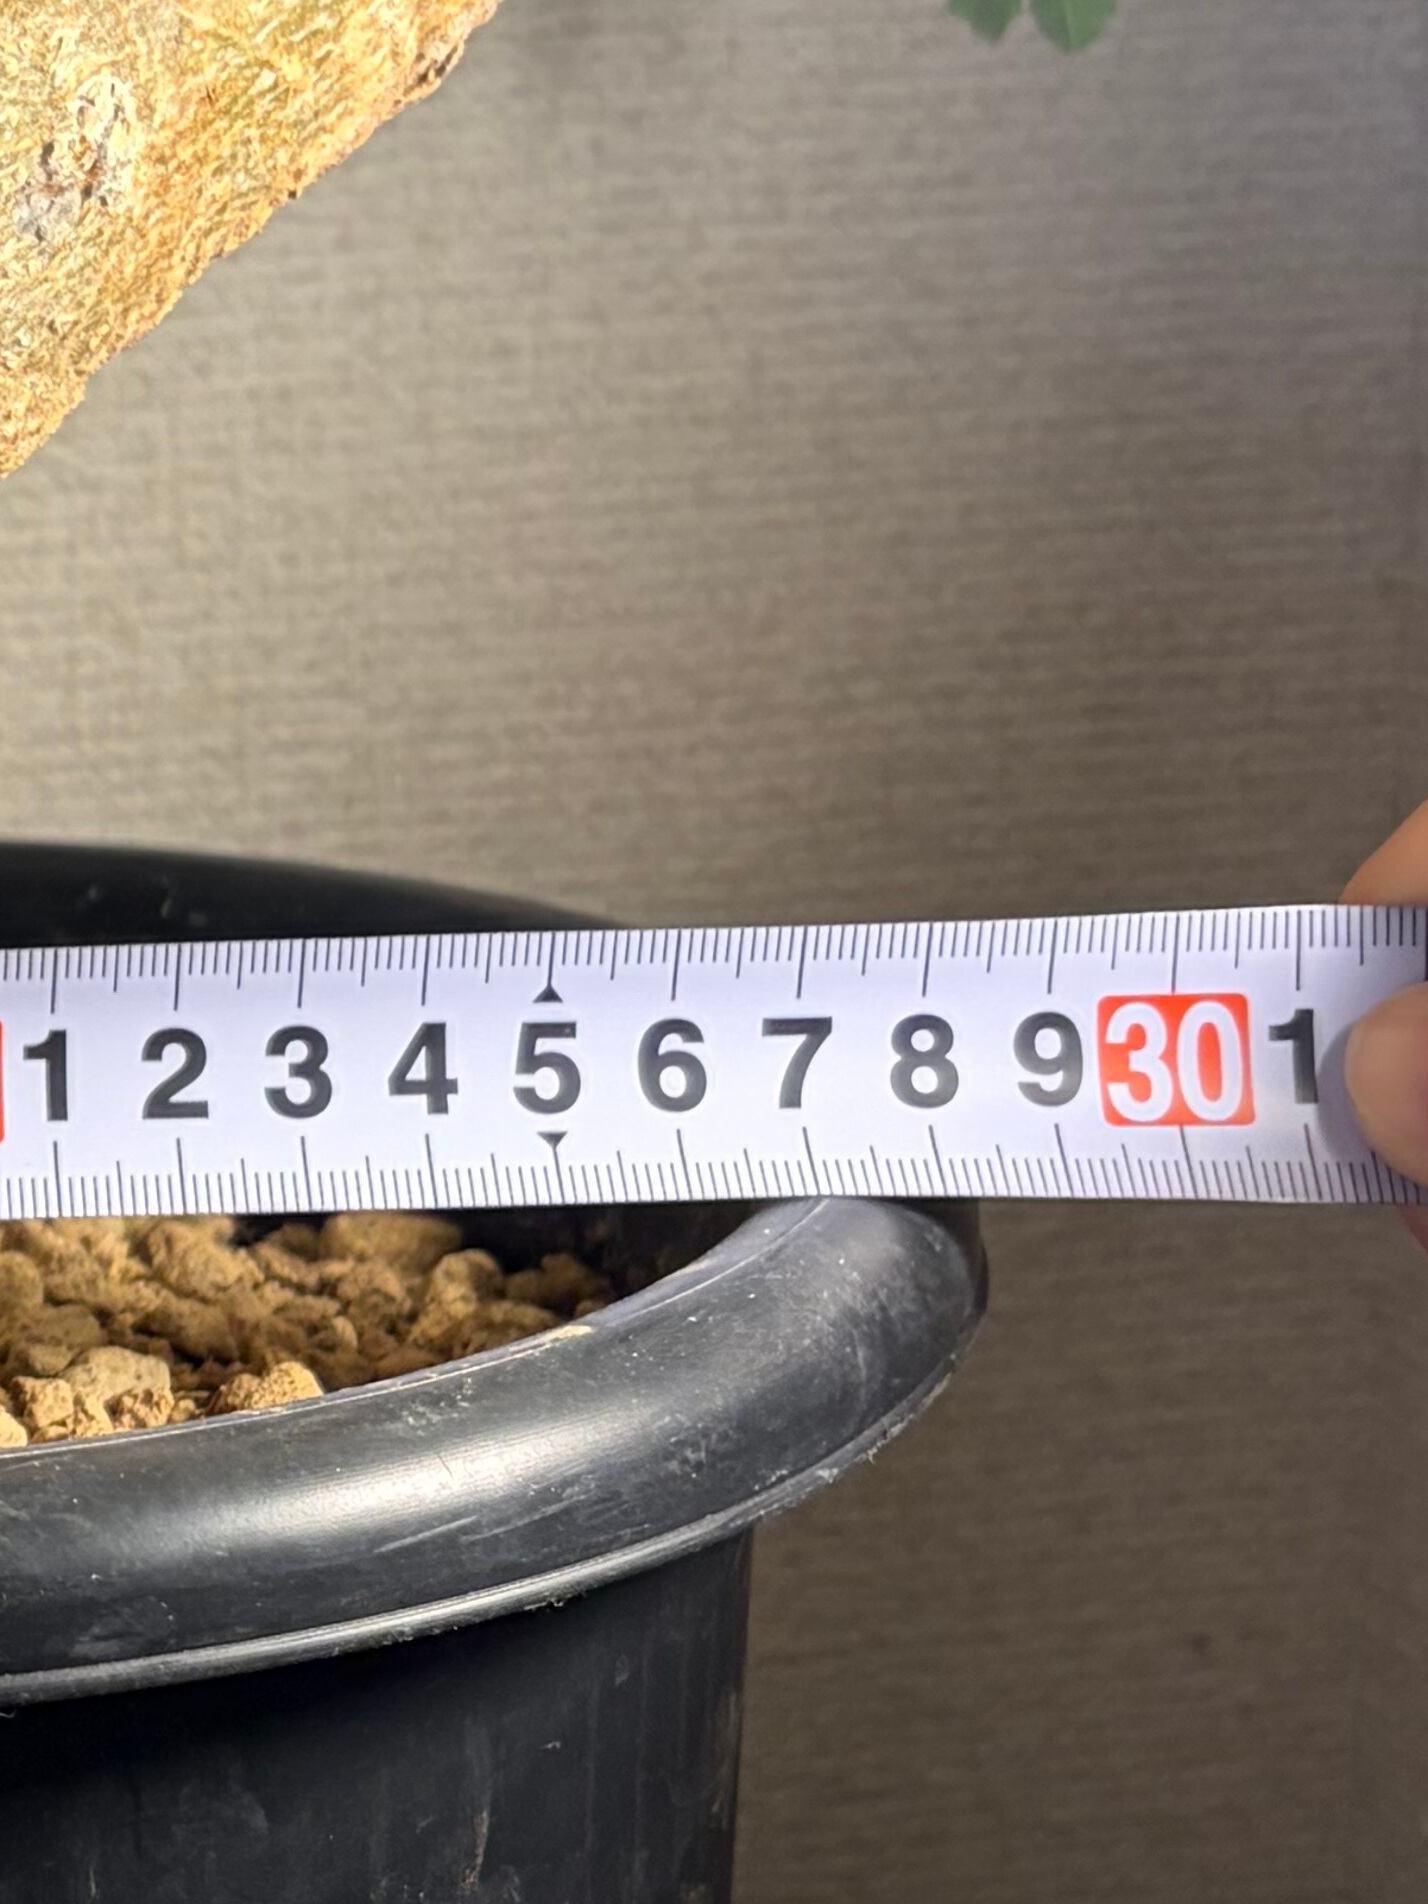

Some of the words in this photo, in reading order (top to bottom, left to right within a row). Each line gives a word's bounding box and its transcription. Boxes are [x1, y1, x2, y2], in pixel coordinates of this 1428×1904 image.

[24, 1029, 68, 1121] 1
[142, 1028, 208, 1119] 2
[266, 1026, 332, 1118] 3
[389, 1023, 458, 1114] 4
[513, 1022, 581, 1114] 5
[638, 1018, 707, 1112] 6
[762, 1016, 832, 1108] 7
[891, 1014, 959, 1108] 8
[1014, 1012, 1083, 1106] 9
[1105, 1001, 1244, 1123] 30
[1268, 1008, 1319, 1105] 1
